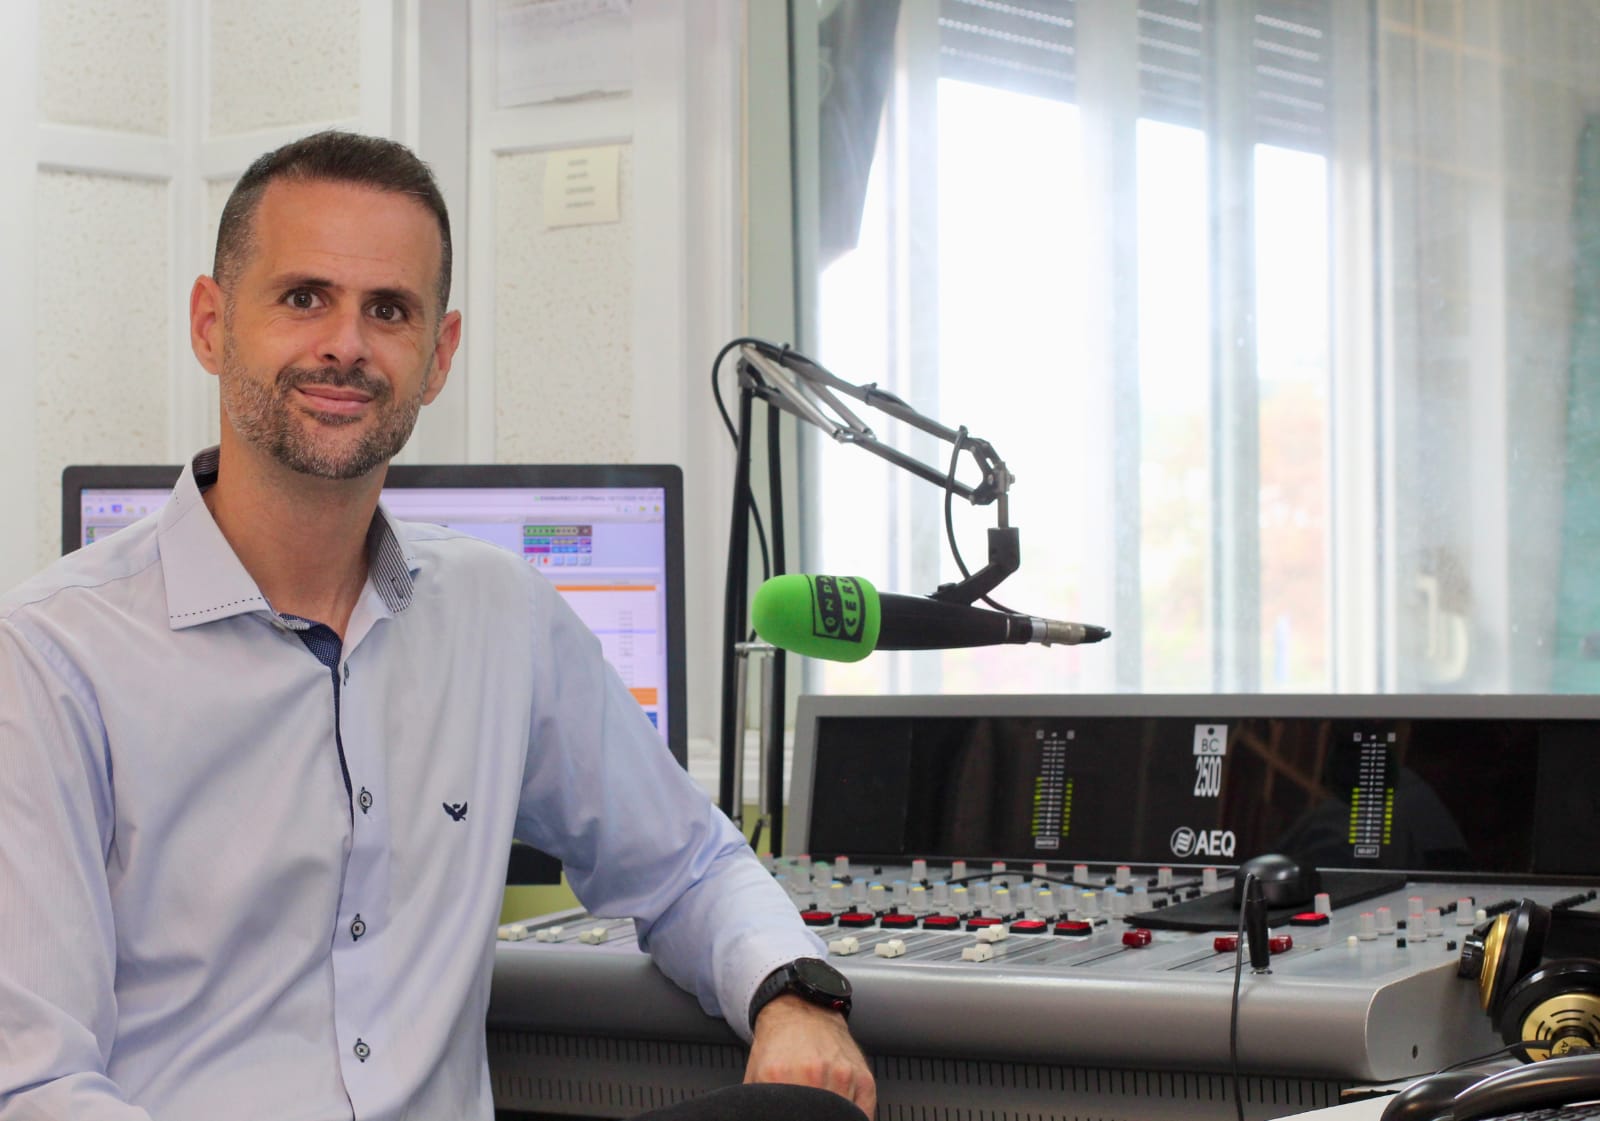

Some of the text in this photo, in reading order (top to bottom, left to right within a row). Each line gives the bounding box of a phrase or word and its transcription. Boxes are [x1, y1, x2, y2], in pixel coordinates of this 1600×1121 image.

[1201, 738, 1220, 753] BC
[1193, 755, 1222, 797] 2500
[1194, 830, 1237, 857] AEQ
